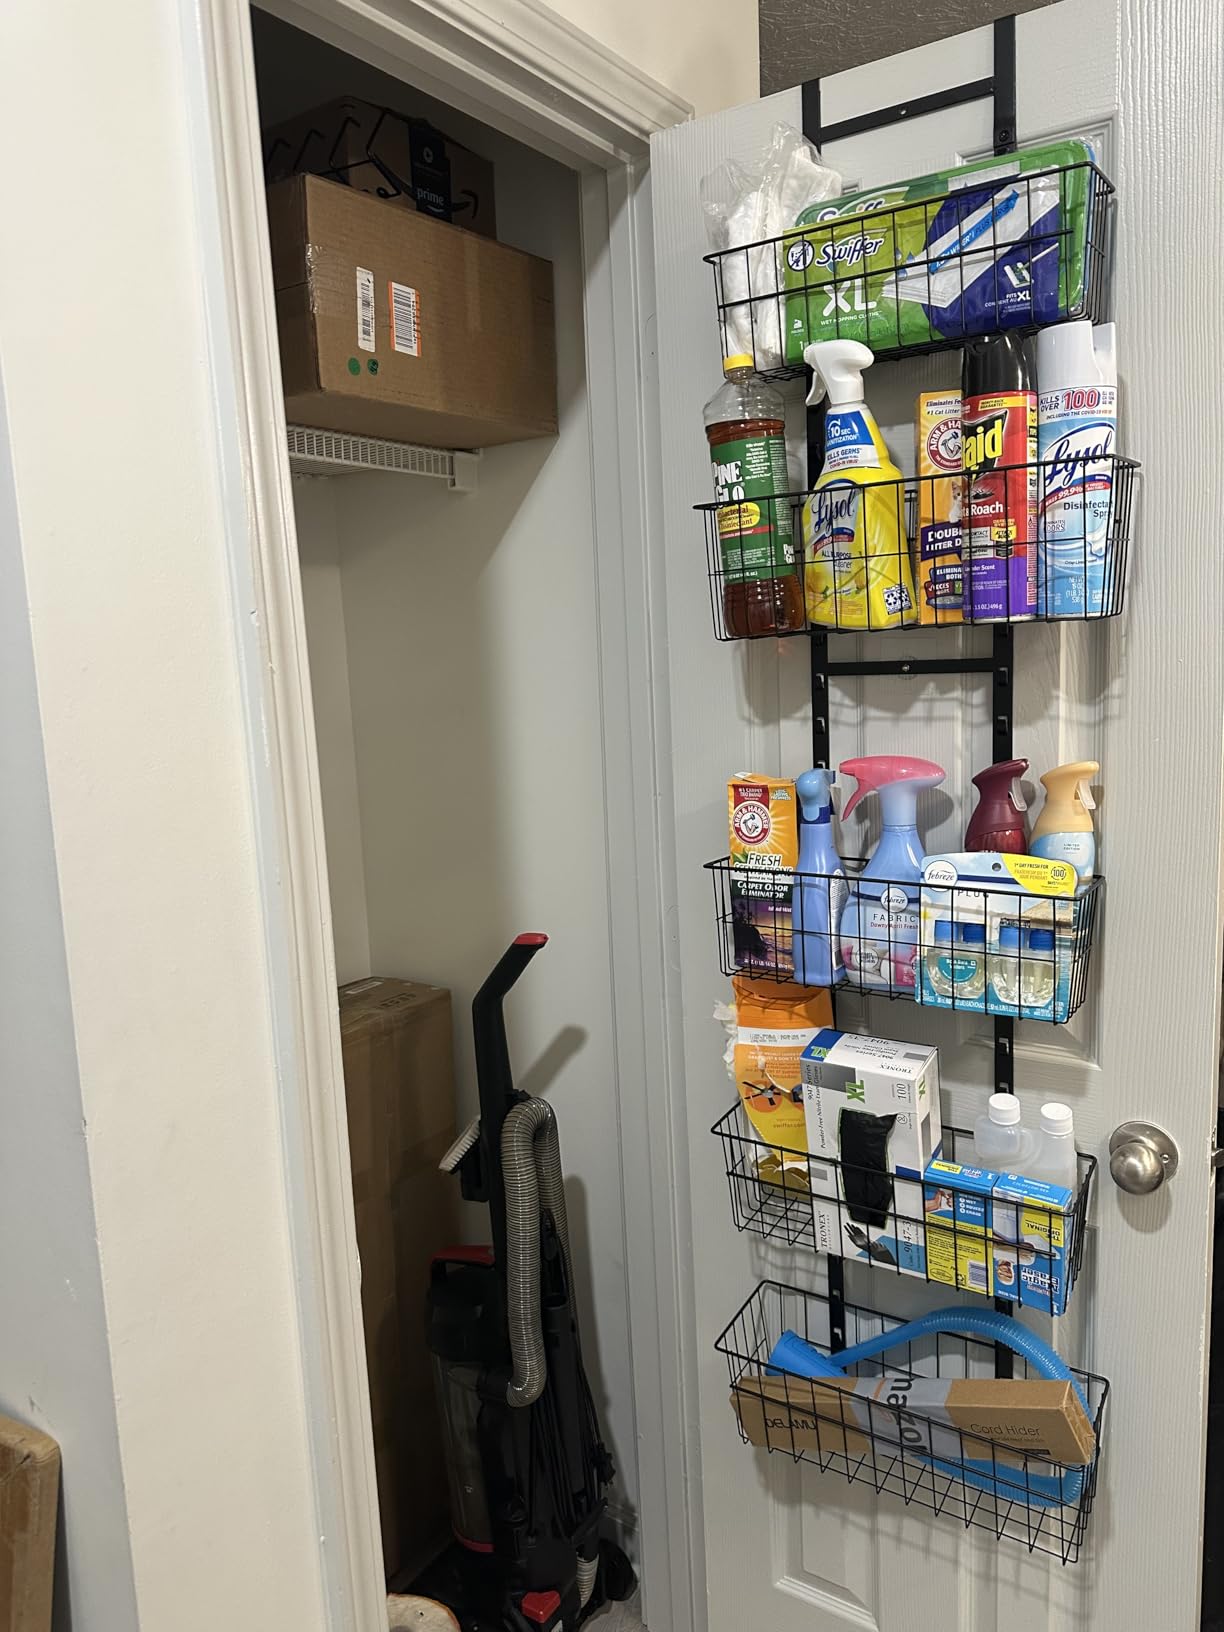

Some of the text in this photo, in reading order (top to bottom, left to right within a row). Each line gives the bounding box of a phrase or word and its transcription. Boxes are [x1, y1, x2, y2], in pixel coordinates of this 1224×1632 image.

[416, 187, 445, 206] prime
[815, 236, 884, 266] Swiffer
[823, 278, 877, 317] XL
[1017, 290, 1031, 302] XL
[820, 318, 833, 326] WET
[858, 311, 880, 319] CLTHS
[926, 398, 953, 407] Eliminates
[1040, 394, 1060, 406] KILLS
[1062, 388, 1101, 412] 100
[944, 408, 960, 416] Litter
[1040, 403, 1060, 412] OVER
[1046, 412, 1070, 420] INCLUDING
[831, 425, 852, 438] 10 SEC
[930, 430, 942, 451] ARM
[840, 447, 860, 456] GERMS
[1044, 430, 1112, 487] Lysol
[712, 460, 743, 487] PINE
[1058, 484, 1083, 500] 99.9%
[811, 488, 856, 533] Lysol
[970, 501, 1004, 516] Roach
[1063, 500, 1111, 512] Disinfecta
[927, 527, 962, 542] DOUB
[954, 538, 962, 547] D
[831, 551, 852, 560] URPOSE
[936, 567, 962, 576] ELIMINA
[748, 853, 782, 867] FRESH
[927, 868, 955, 882] febreze
[1053, 869, 1065, 878] 100
[737, 880, 789, 893] CARPET ODOR
[870, 921, 888, 929] Downy
[873, 913, 916, 923] FABRIC
[811, 1045, 832, 1058] XL
[855, 1049, 877, 1057] Series
[879, 1064, 912, 1075] TRONEX
[805, 1064, 815, 1101] 9047 Series
[845, 1080, 866, 1104] XL
[896, 1083, 907, 1100] 100
[817, 1117, 827, 1150] Powder-Free
[819, 1212, 828, 1248] TRONEX
[902, 1220, 913, 1253] 9047-3
[1022, 1267, 1059, 1284] Eraser
[1022, 1275, 1059, 1293] Magic
[765, 1417, 817, 1431] DELAMU
[970, 1423, 1041, 1437] Cord Hider
